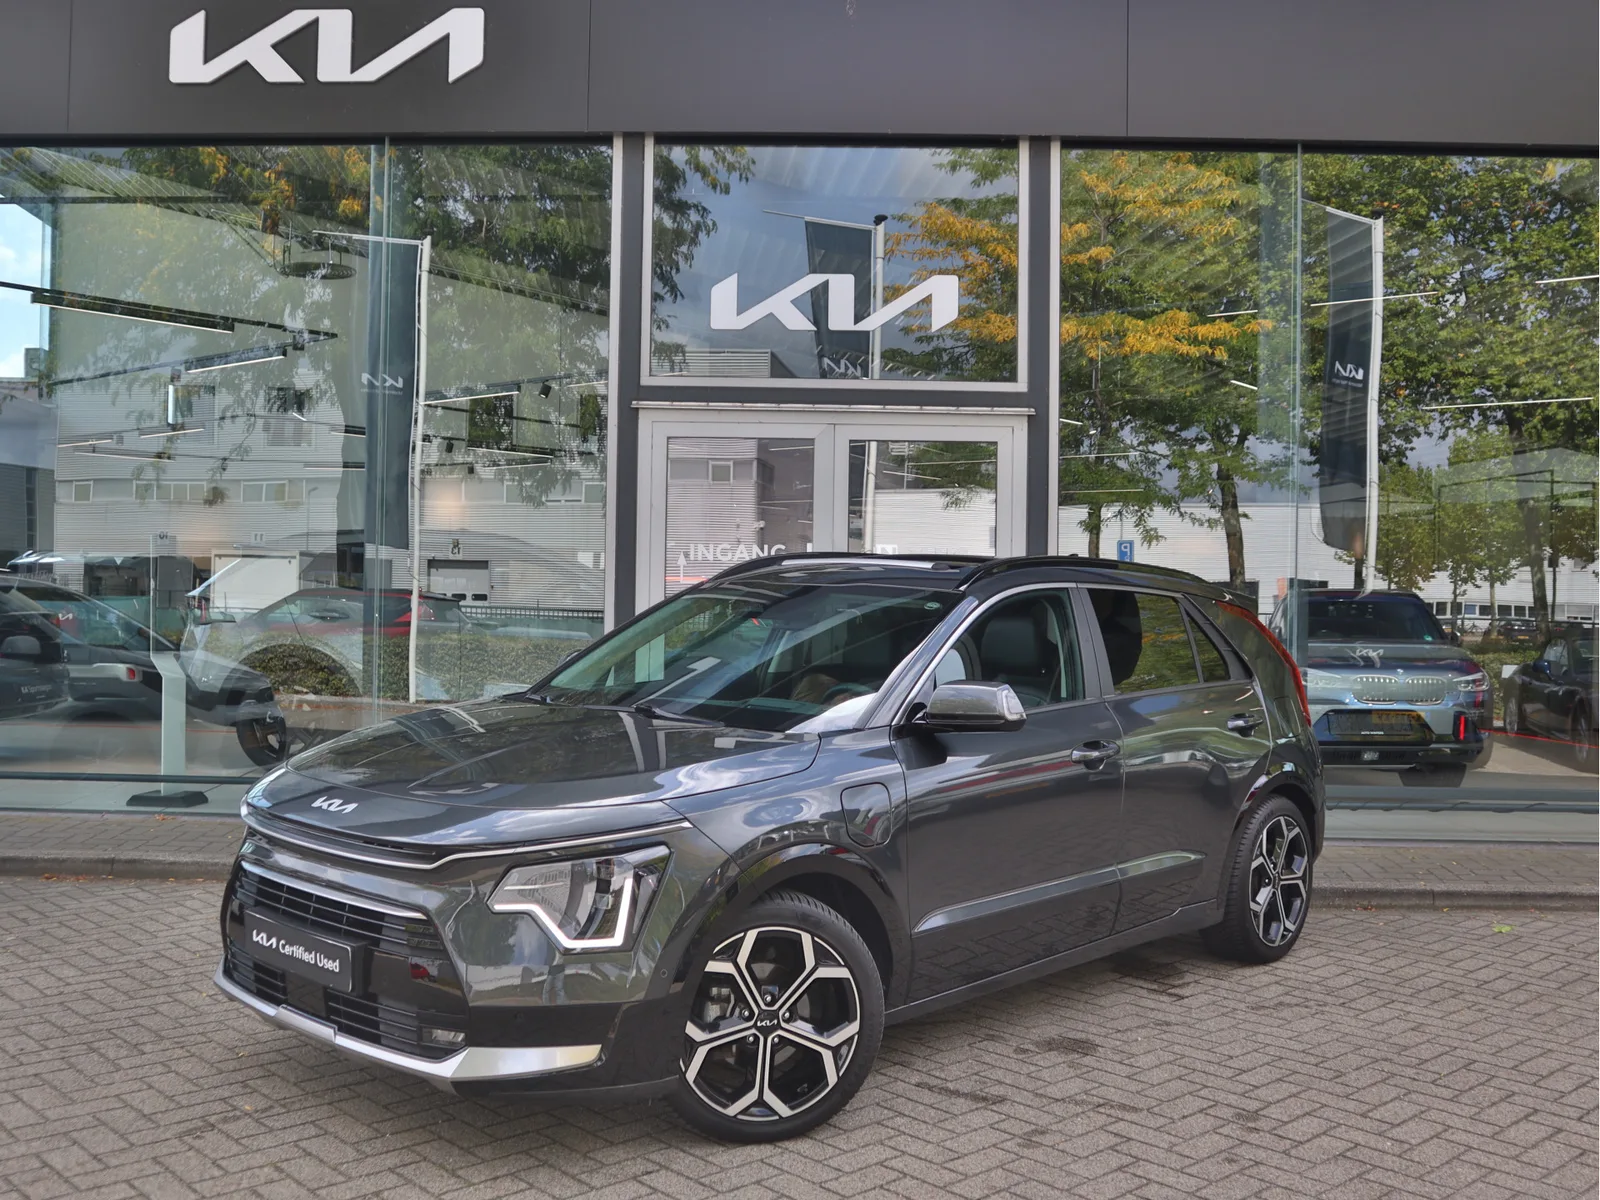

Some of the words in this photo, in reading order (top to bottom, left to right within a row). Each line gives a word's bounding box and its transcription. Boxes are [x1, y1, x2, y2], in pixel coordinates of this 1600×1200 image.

[169, 7, 485, 84] KIA
[710, 272, 959, 333] KIA
[311, 796, 358, 814] KIA
[252, 929, 276, 949] KIA
[279, 940, 315, 964] Certified
[316, 953, 339, 972] Used
[757, 1019, 777, 1027] KIA
